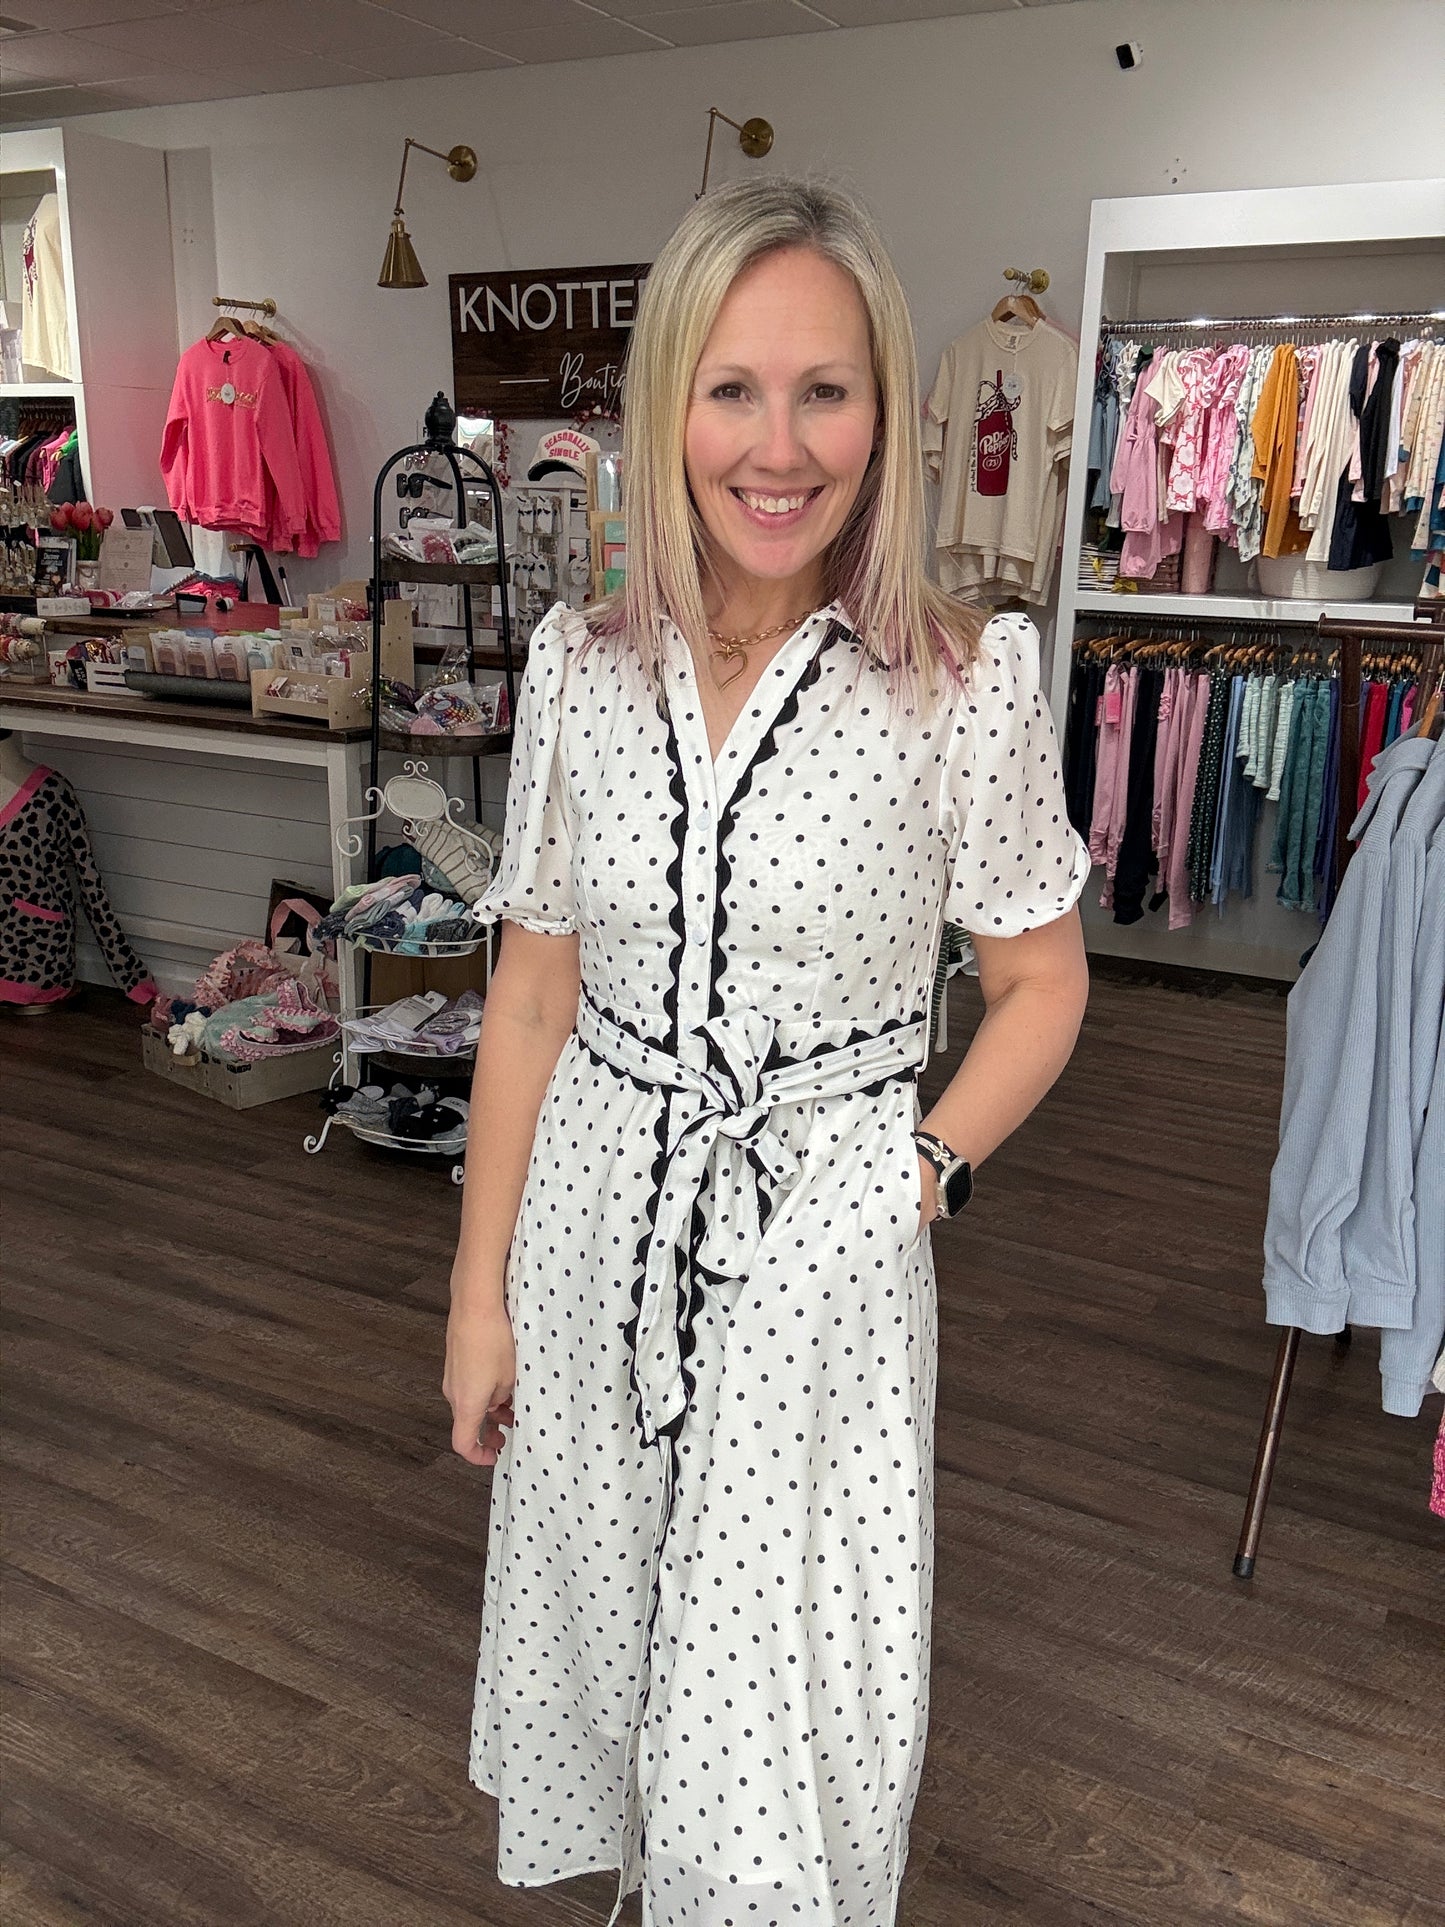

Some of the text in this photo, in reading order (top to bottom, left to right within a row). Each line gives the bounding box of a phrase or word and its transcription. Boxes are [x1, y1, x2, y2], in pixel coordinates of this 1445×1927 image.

[544, 432, 591, 452] SEASONALLY
[980, 434, 1010, 455] Pepper
[992, 431, 1005, 444] Dr
[549, 448, 580, 461] SINGLE
